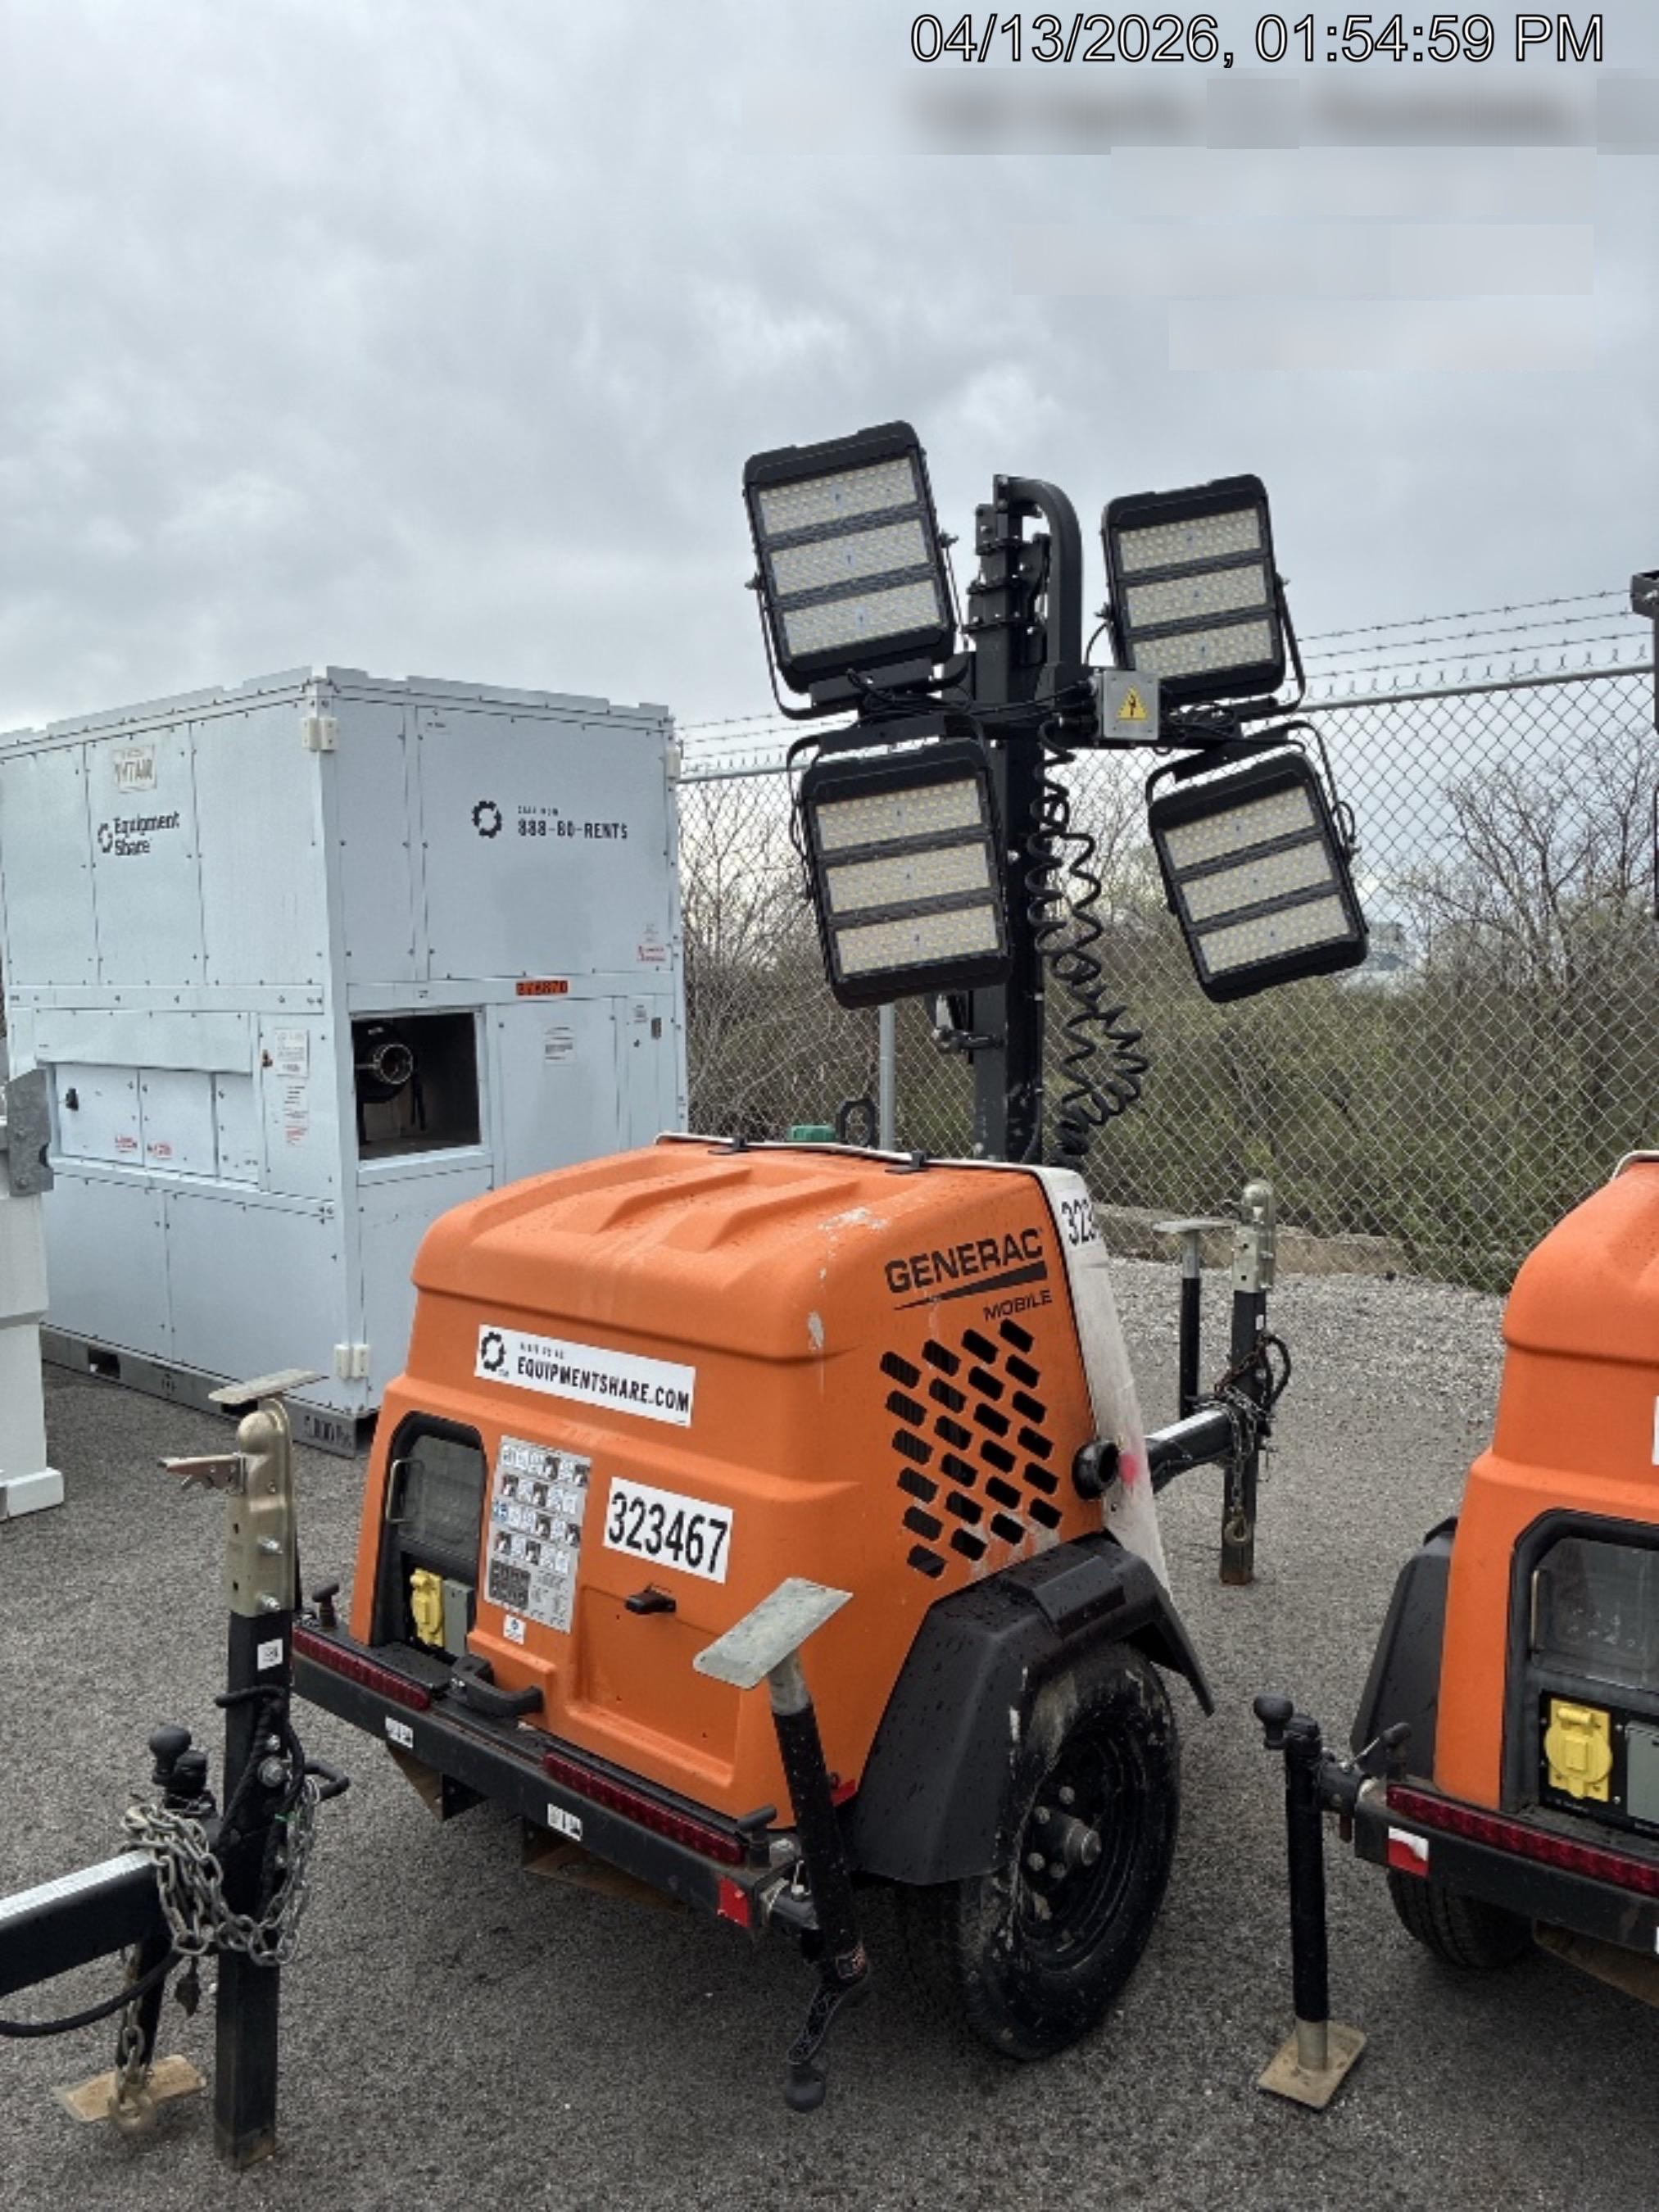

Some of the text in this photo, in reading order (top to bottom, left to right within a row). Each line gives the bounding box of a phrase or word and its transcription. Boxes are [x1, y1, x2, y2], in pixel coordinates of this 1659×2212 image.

[113, 810, 179, 838] Equipment
[115, 838, 151, 856] Share
[885, 1229, 1043, 1293] GENERAC
[983, 1290, 1053, 1321] MOBILE
[518, 1357, 690, 1413] EQUIPMENTSHARE.COM
[609, 1492, 728, 1574] 323467
